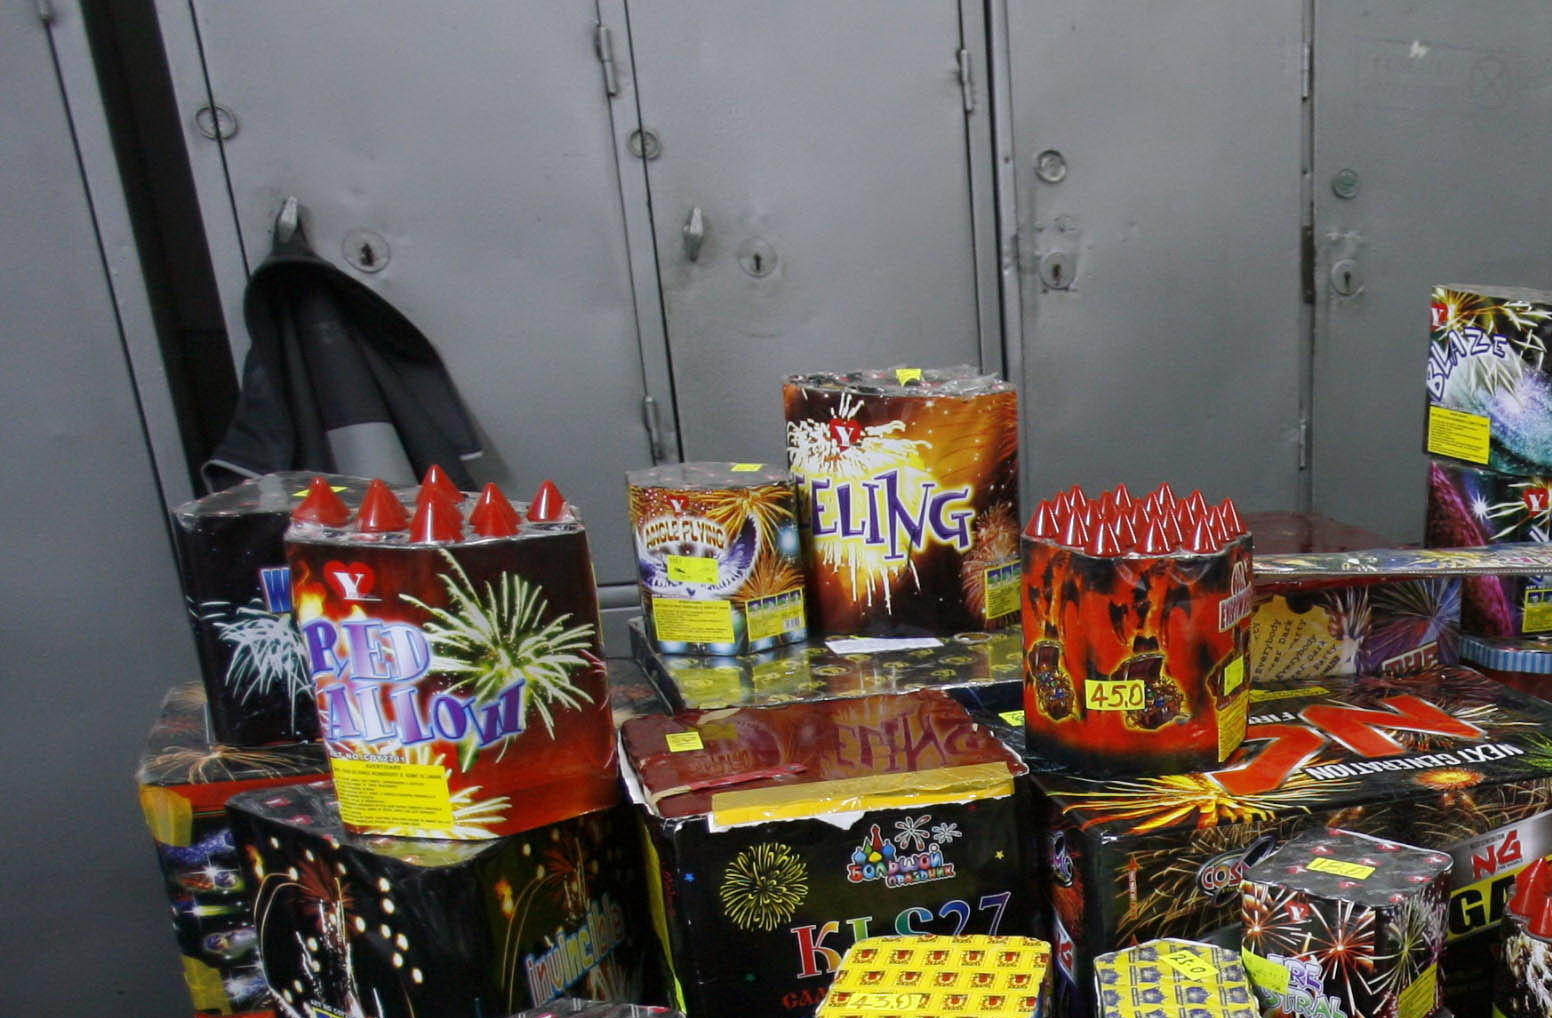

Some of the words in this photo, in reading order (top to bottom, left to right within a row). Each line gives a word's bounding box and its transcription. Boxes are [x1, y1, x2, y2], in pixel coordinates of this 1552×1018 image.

[1426, 326, 1509, 402] BLAZE
[796, 470, 972, 560] ELING
[304, 618, 431, 683] RED
[1249, 710, 1298, 725] FIR
[1305, 754, 1464, 781] GENERATION
[1456, 743, 1524, 763] NEXT
[848, 842, 945, 883] БОЛЬШОЙ
[1471, 829, 1524, 880] NG
[885, 864, 956, 888] ПРАЗДНИК
